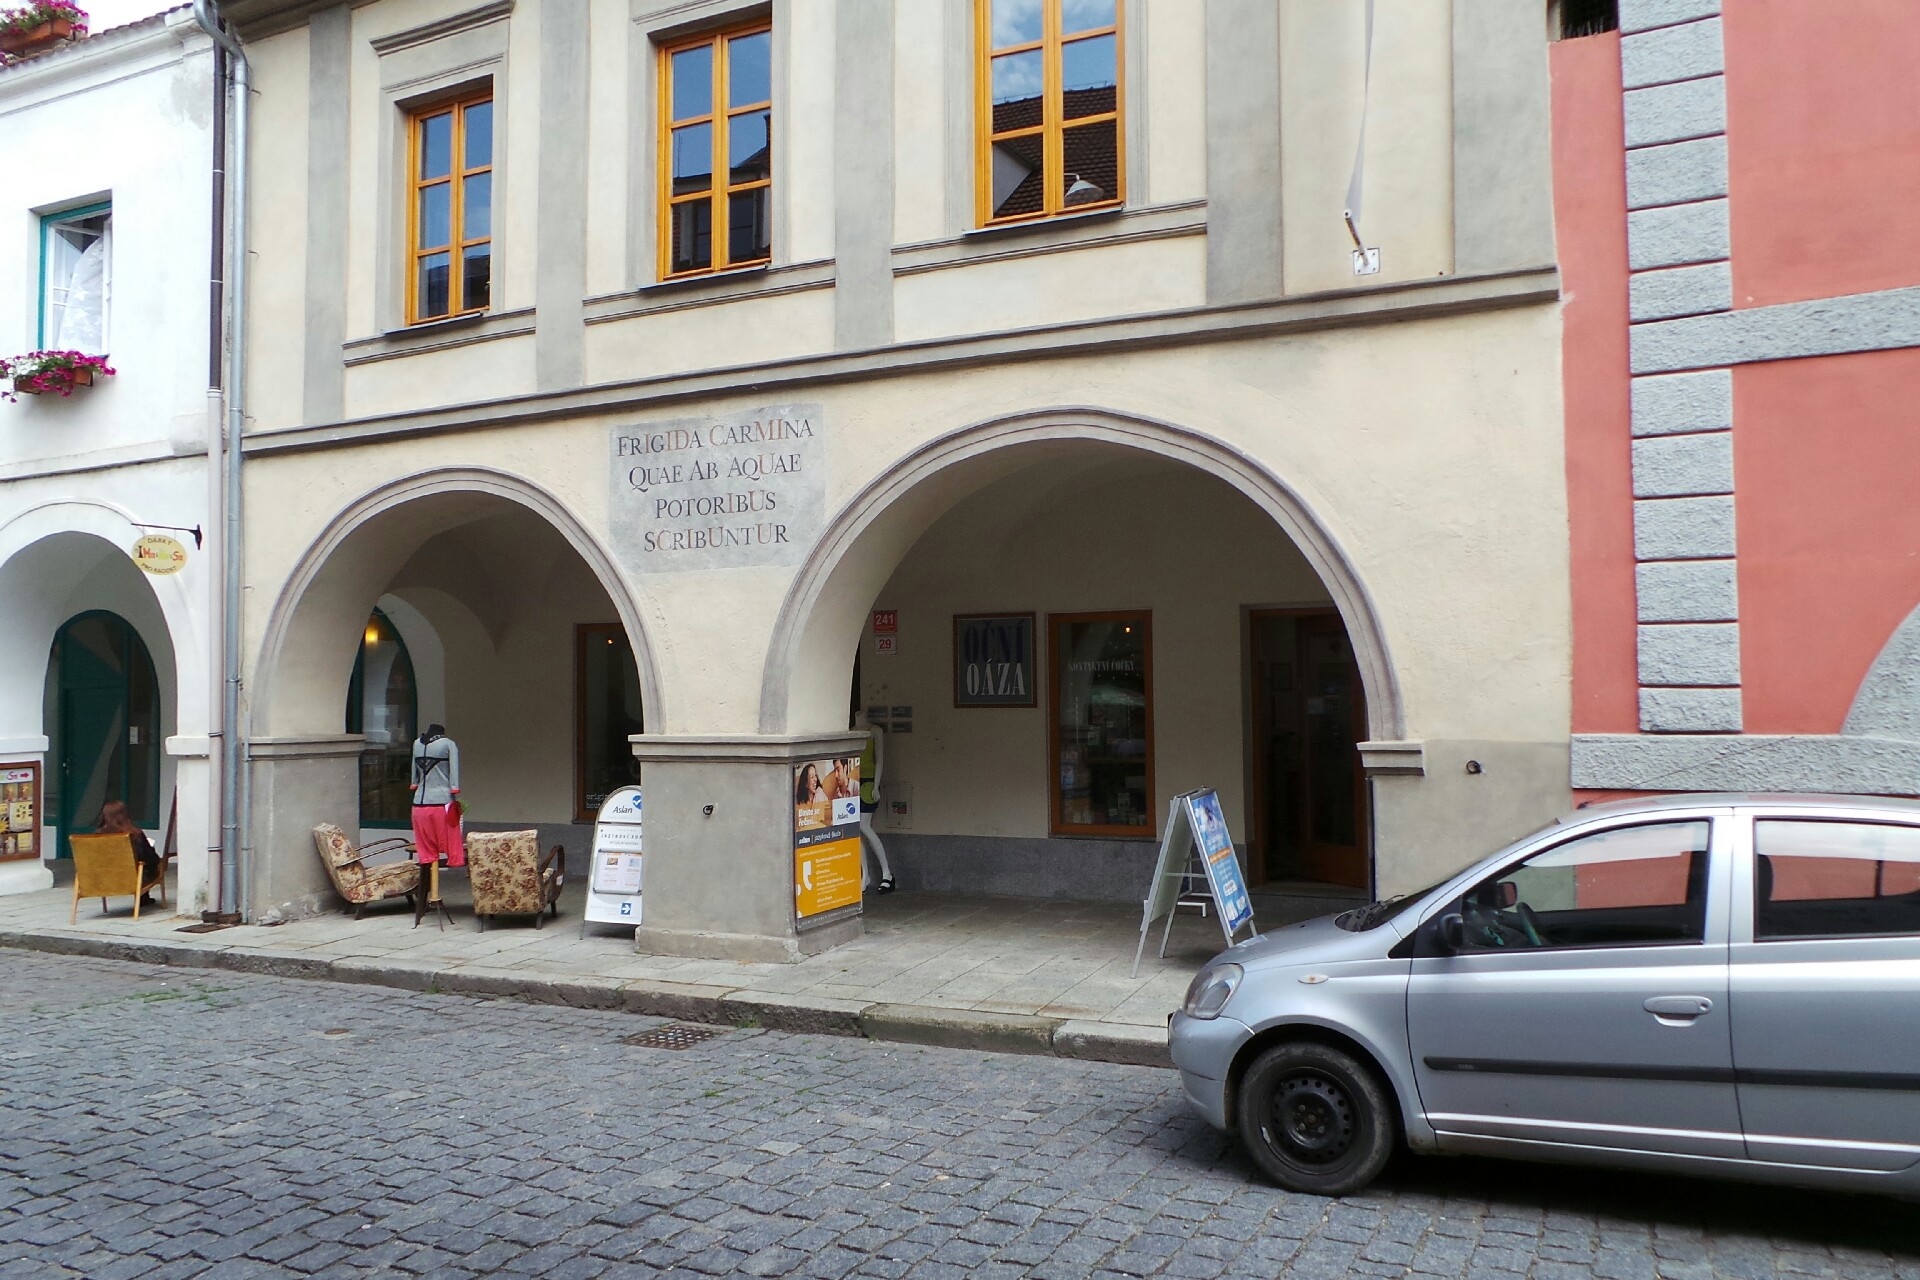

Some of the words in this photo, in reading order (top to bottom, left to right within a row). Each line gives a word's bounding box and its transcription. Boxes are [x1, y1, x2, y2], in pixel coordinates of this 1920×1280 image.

[617, 429, 704, 457] FRIGIDA
[709, 418, 815, 447] CARMINA
[628, 464, 683, 493] QUAE
[727, 453, 802, 481] AQUAE
[654, 489, 776, 519] POTORIBUS
[643, 523, 790, 552] SCRIBUNTUR
[875, 614, 895, 625] 241
[879, 639, 892, 649] 29
[964, 618, 1026, 664] OČNÍ
[966, 658, 1026, 696] OÁZA
[612, 805, 633, 814] Aslan
